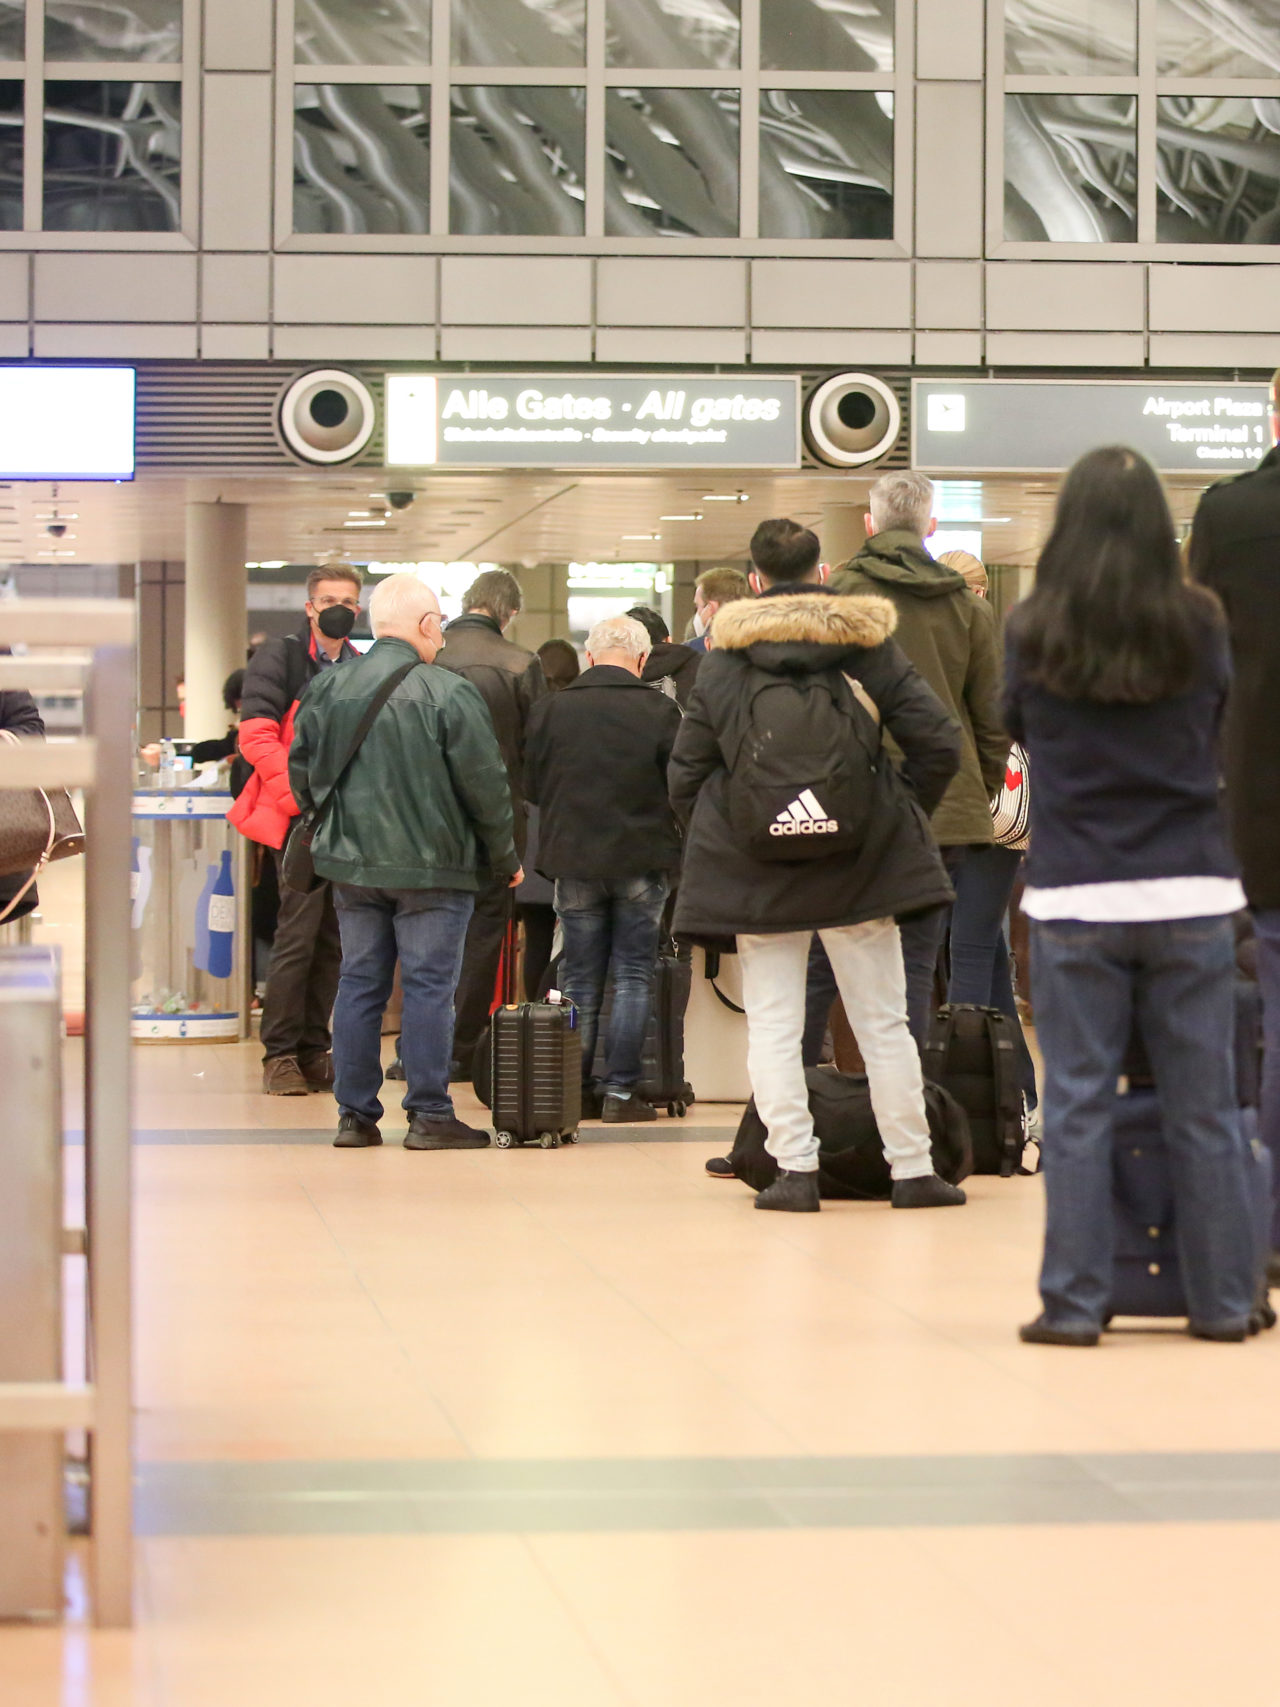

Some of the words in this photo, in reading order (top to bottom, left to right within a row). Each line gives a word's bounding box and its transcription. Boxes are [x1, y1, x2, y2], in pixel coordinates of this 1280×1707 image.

[441, 389, 509, 420] Alle
[516, 389, 612, 420] Gates
[635, 390, 686, 420] All
[689, 394, 781, 427] gates
[1143, 397, 1211, 419] Airport
[1214, 397, 1263, 416] Plaza
[1166, 423, 1249, 443] Terminal
[1253, 425, 1263, 443] 1
[769, 819, 839, 836] adidas
